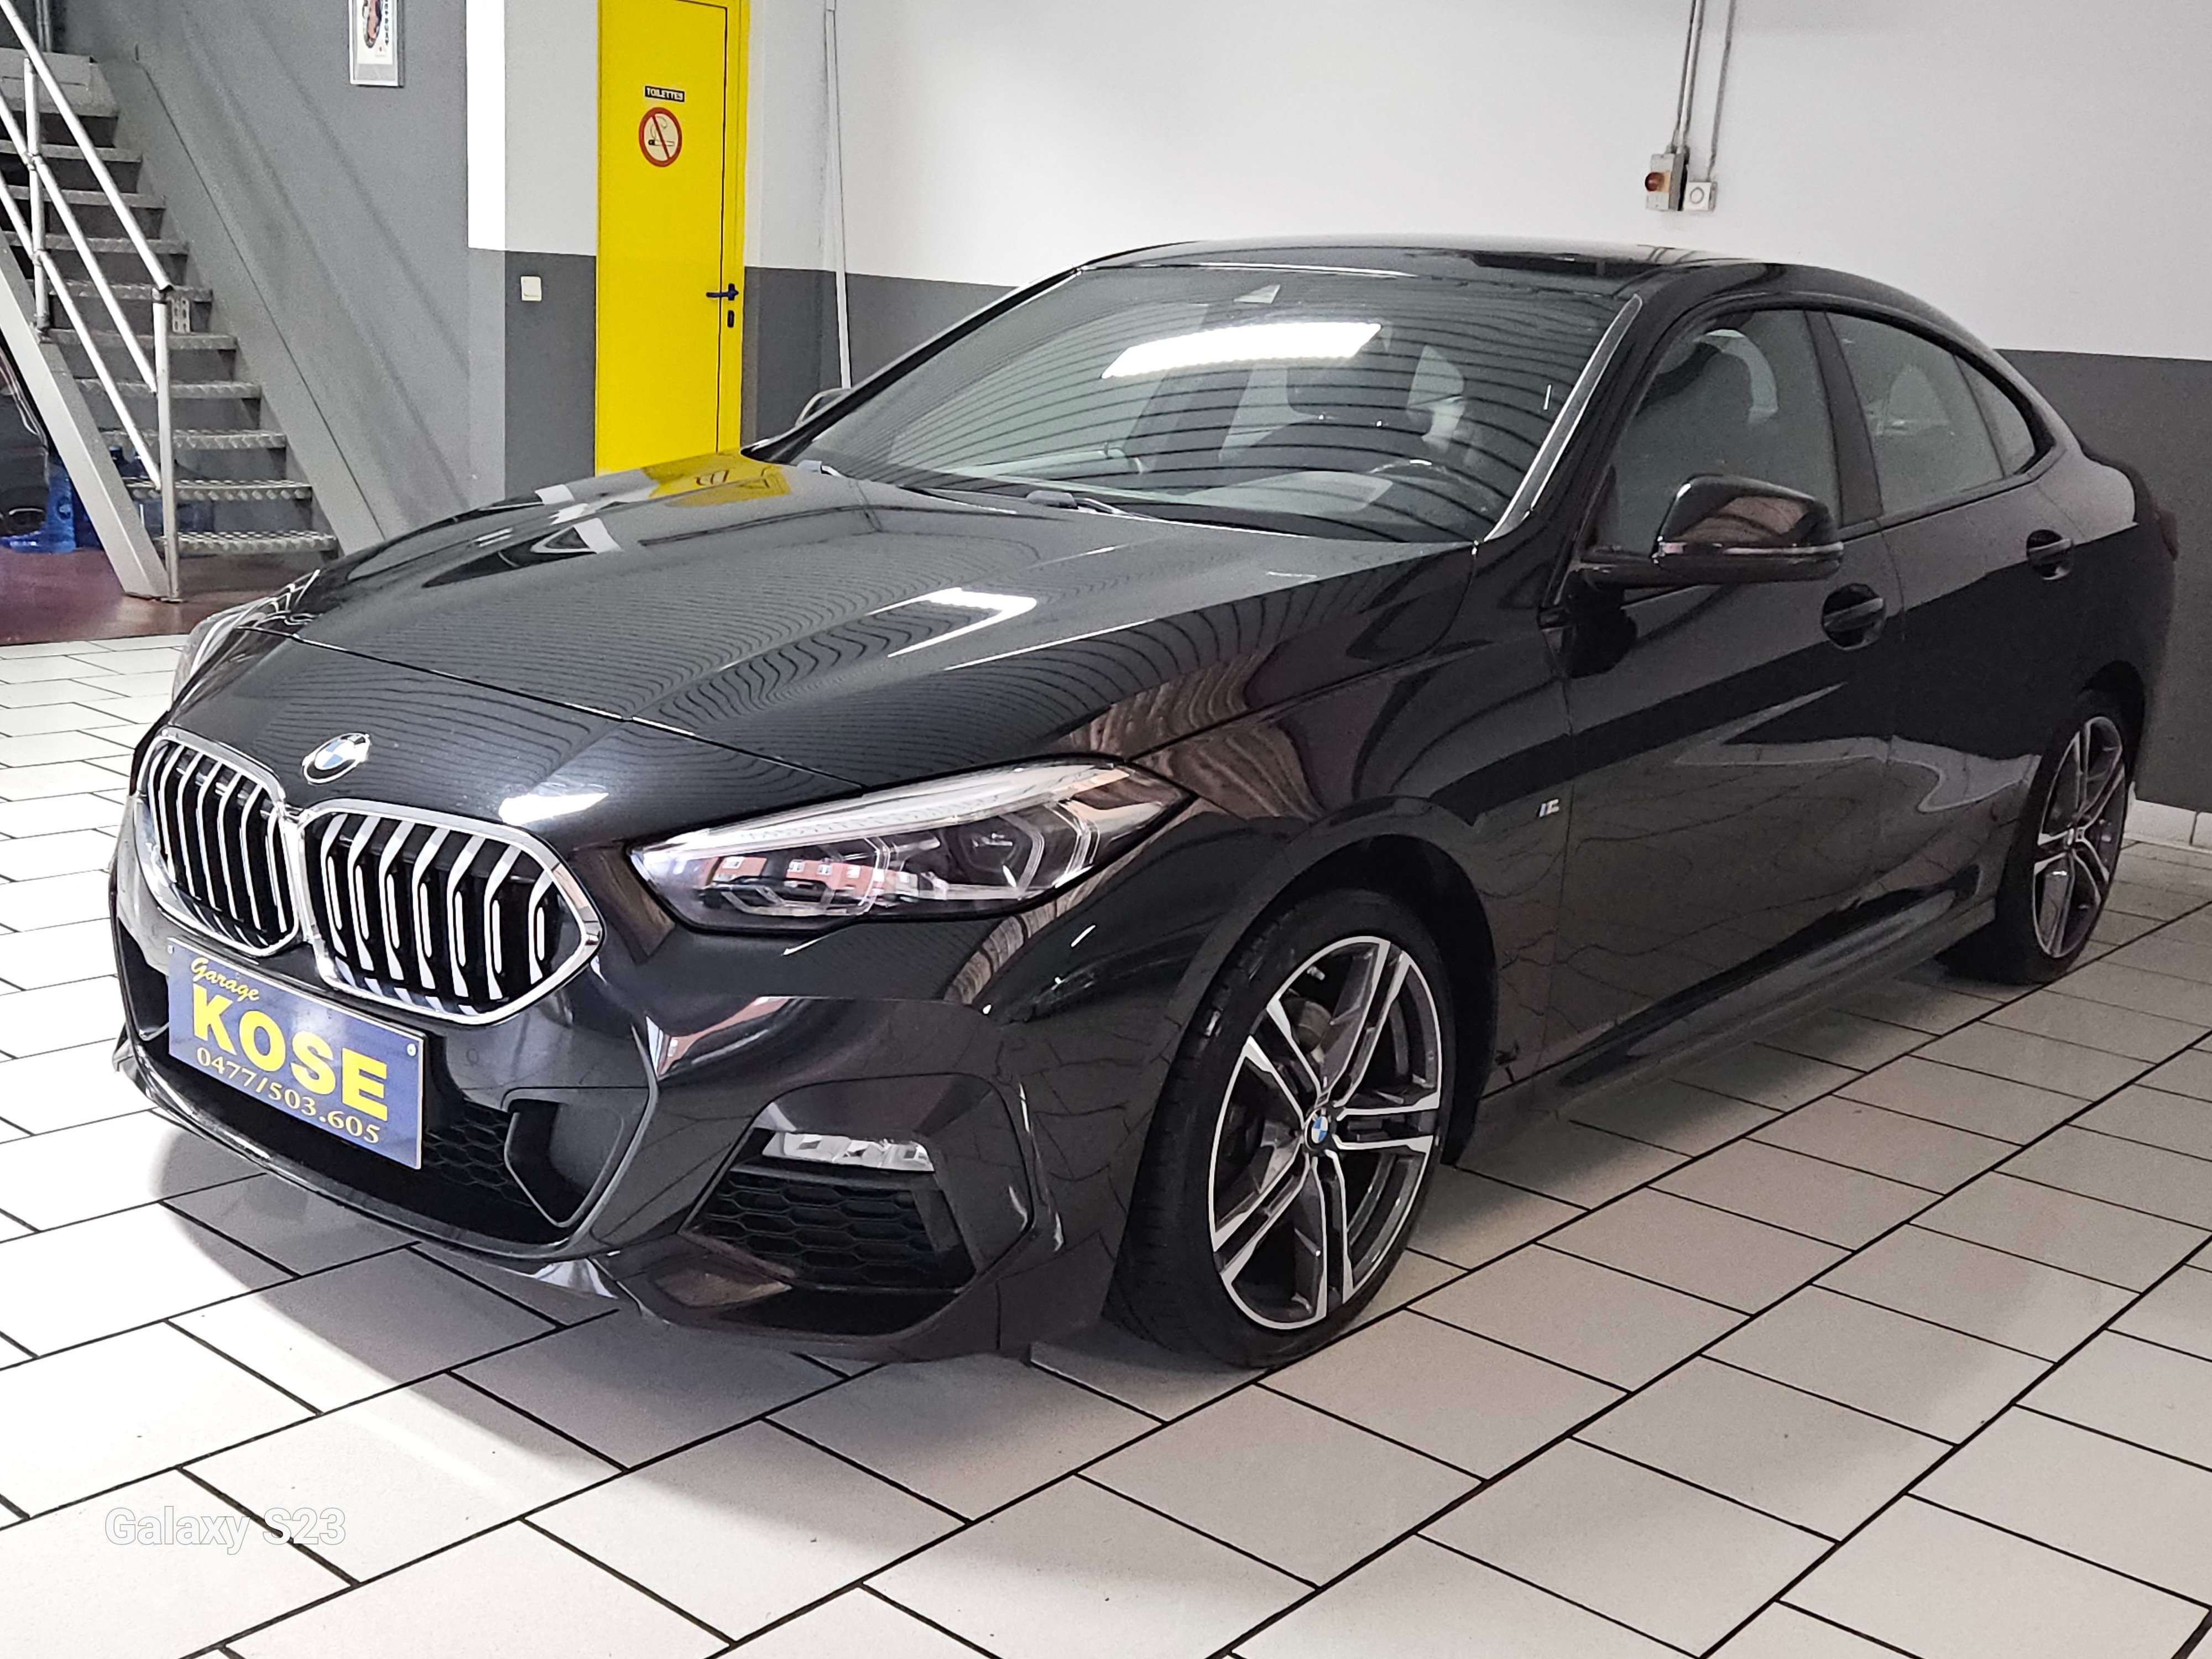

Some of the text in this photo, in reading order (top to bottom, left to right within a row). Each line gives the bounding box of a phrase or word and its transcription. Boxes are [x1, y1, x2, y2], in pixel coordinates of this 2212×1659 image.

[191, 957, 259, 1001] Garage
[192, 983, 388, 1122] KOSE
[196, 1047, 380, 1144] 0477/503.605
